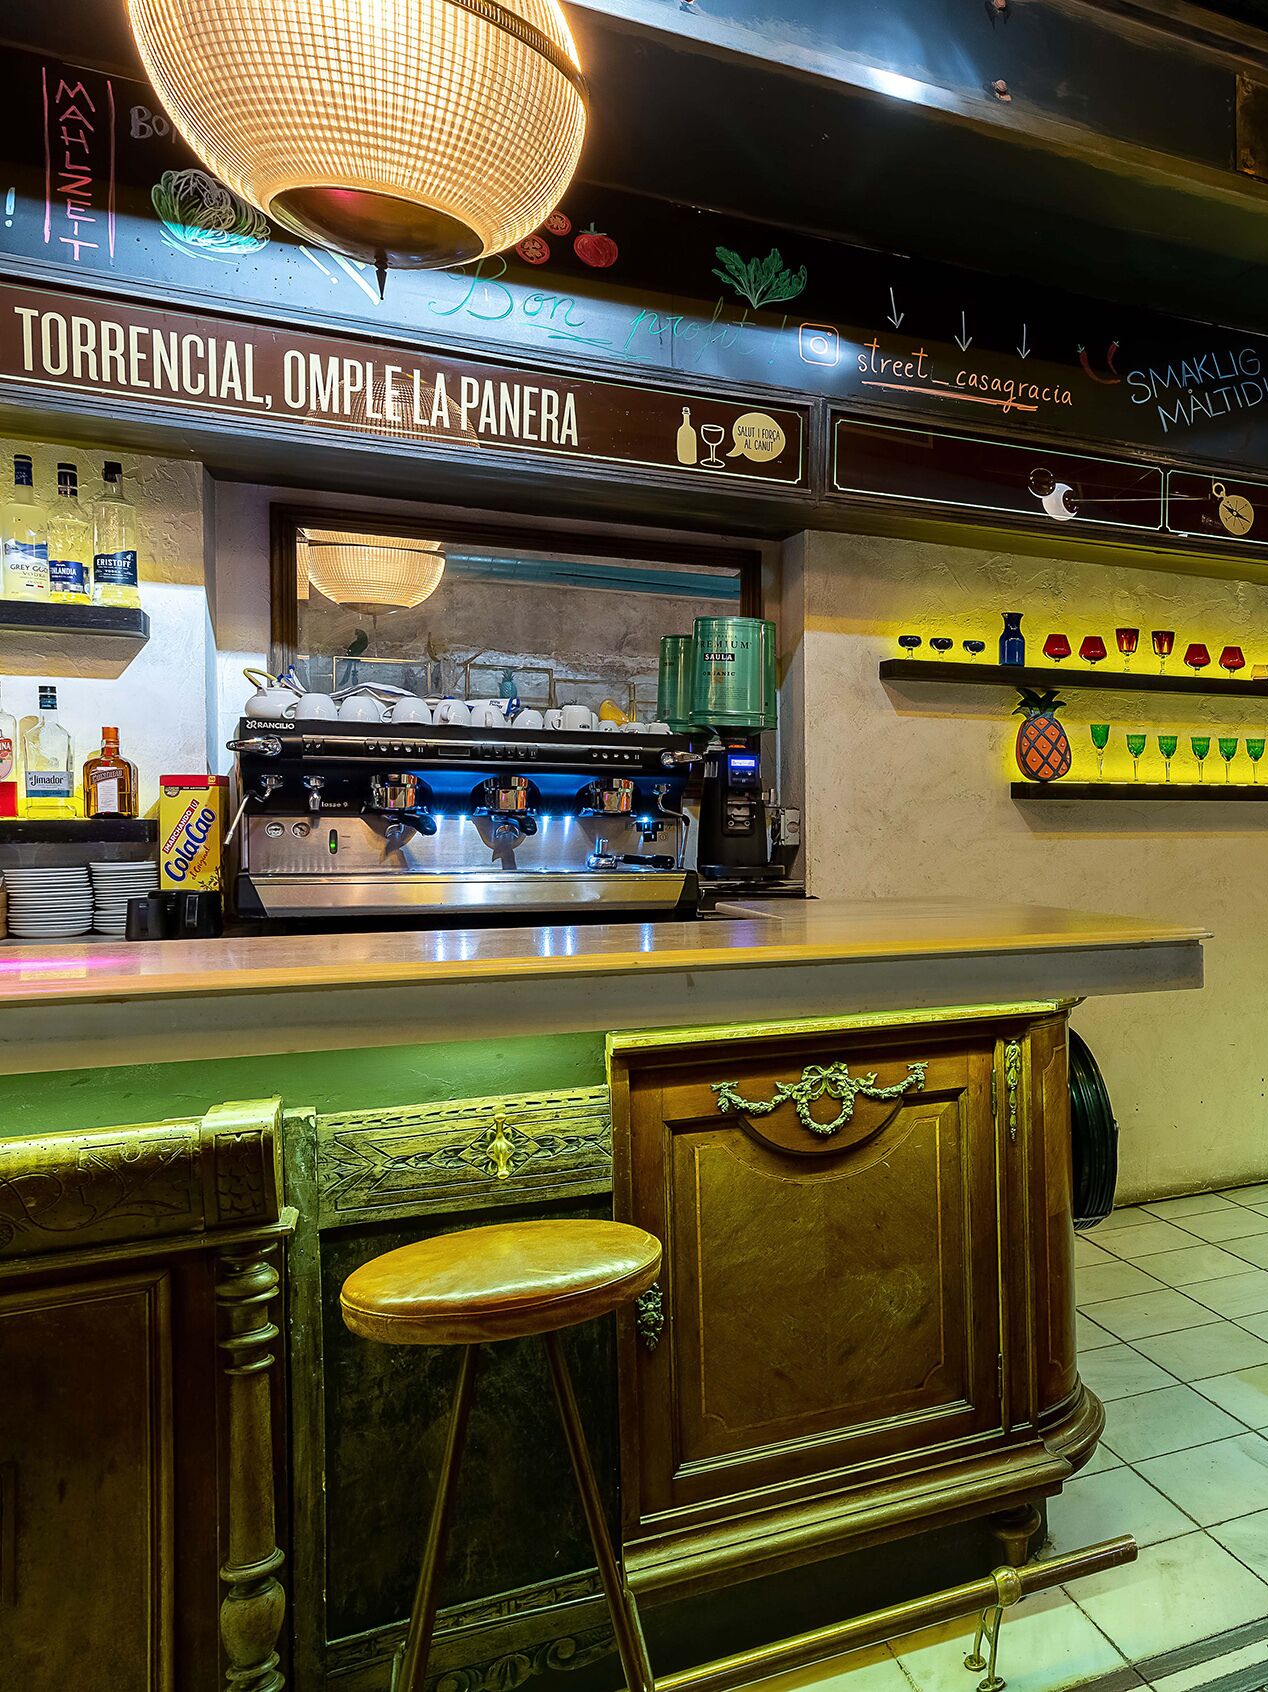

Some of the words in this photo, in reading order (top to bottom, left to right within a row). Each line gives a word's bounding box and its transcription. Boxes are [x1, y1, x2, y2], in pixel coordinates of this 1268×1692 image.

[427, 255, 586, 328] Bon
[14, 306, 273, 411] TORRENCIAL,
[283, 349, 402, 425] OMPLE
[413, 367, 451, 429] LA
[460, 375, 579, 446] PANERA
[1126, 348, 1261, 404] SMAKLIG
[737, 425, 755, 438] SALUT
[761, 428, 781, 442] FORÇA
[744, 438, 752, 450] AL
[754, 440, 774, 451] CANUT
[96, 558, 132, 568] ERISTOFF
[704, 653, 734, 661] SAULA
[257, 721, 295, 730] RANCILIO
[30, 774, 64, 786] Jimador
[163, 807, 216, 883] ColaCao
